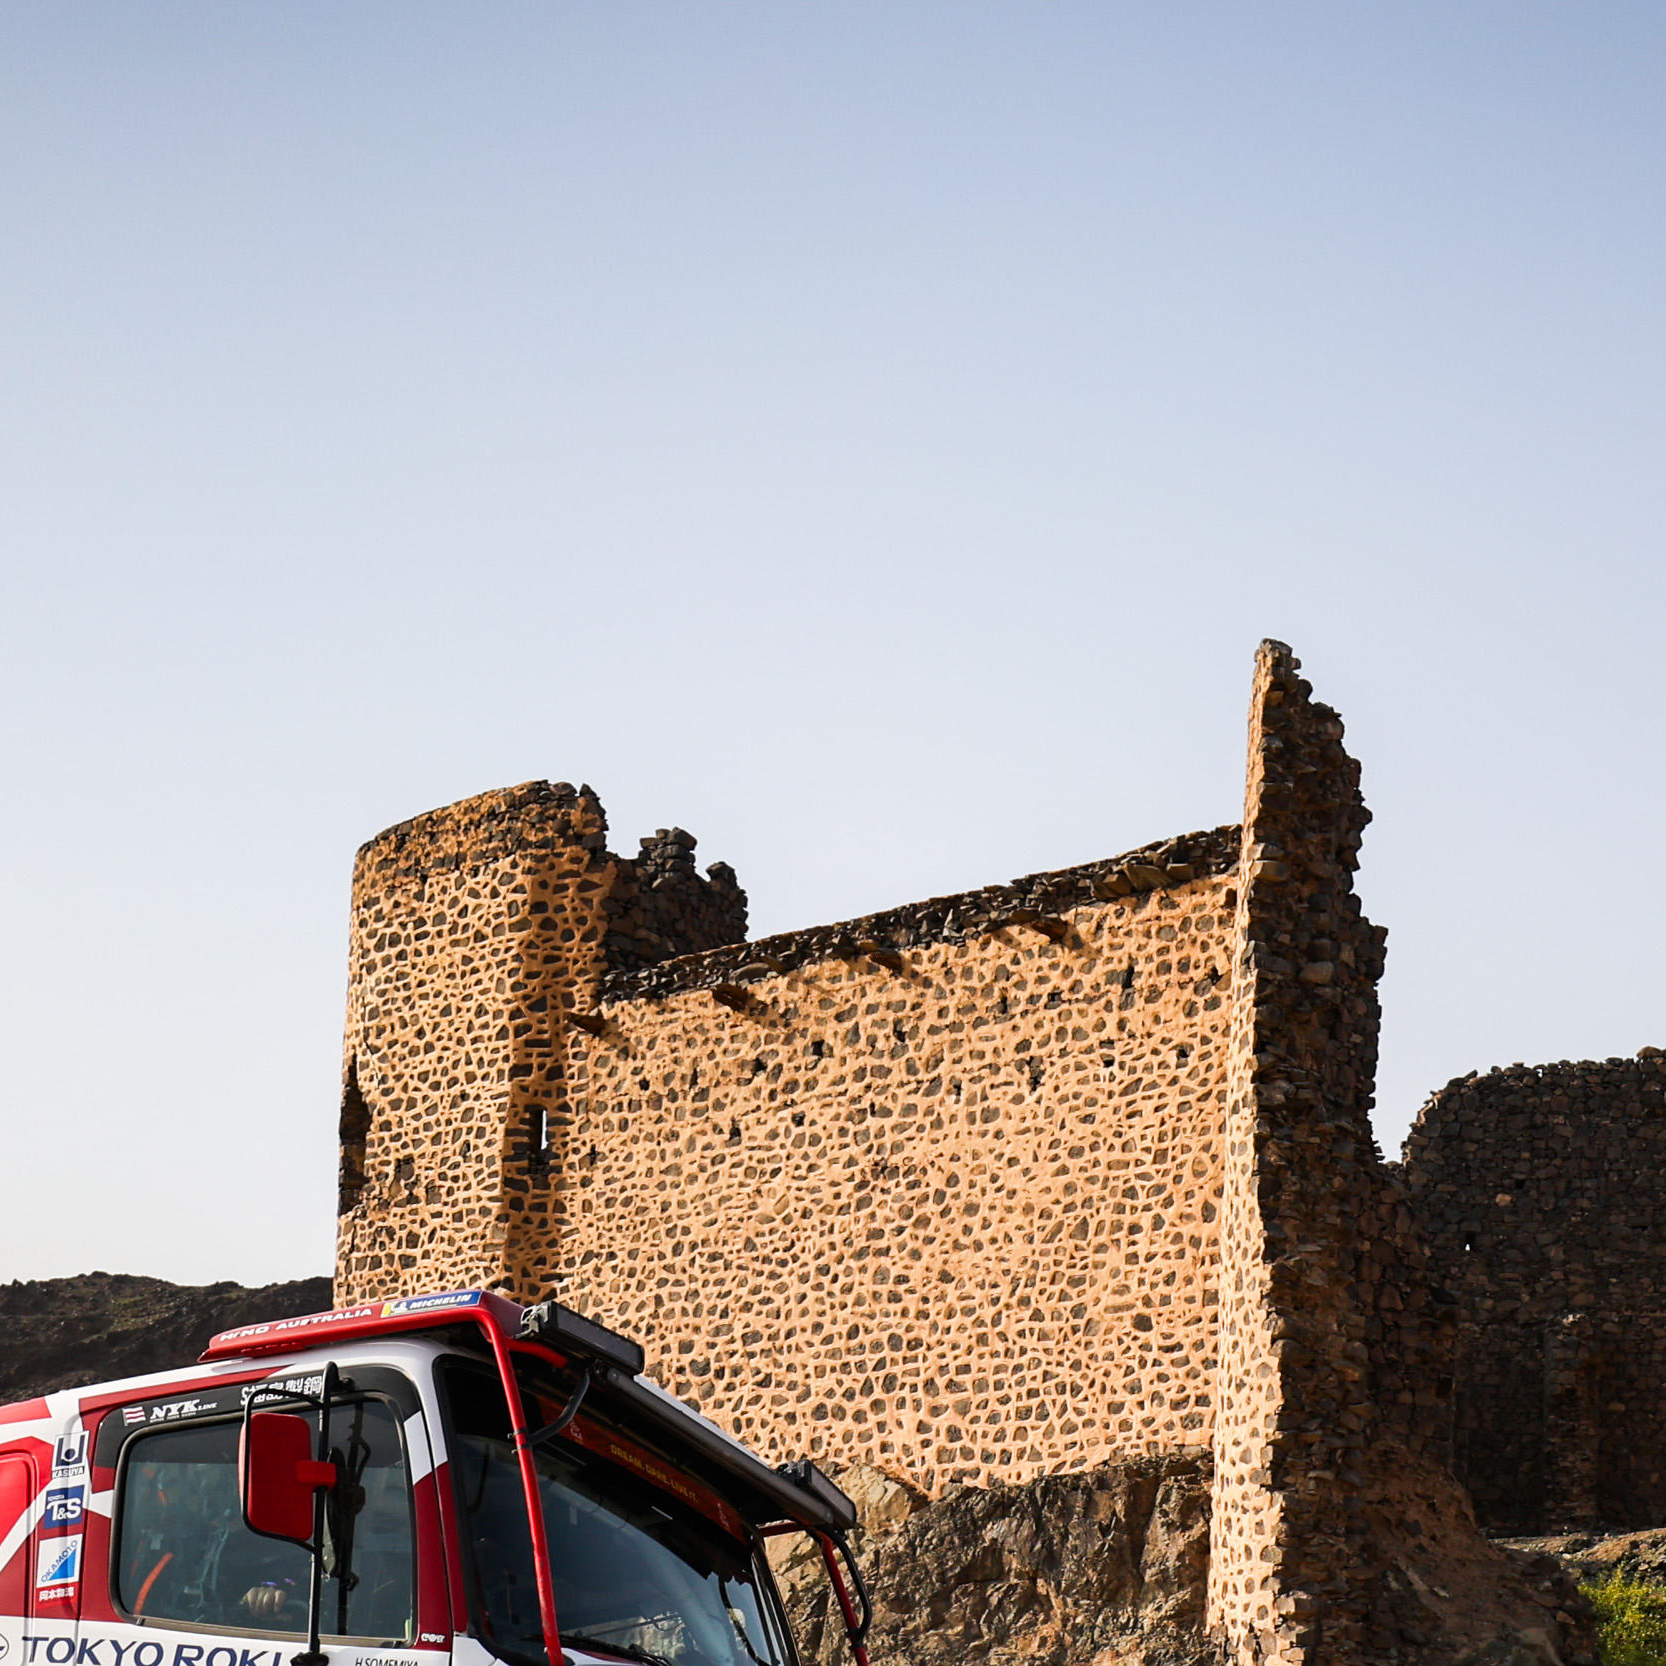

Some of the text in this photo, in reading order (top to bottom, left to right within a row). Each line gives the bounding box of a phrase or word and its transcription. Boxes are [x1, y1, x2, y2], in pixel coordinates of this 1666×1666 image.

[410, 1294, 472, 1309] MICHELIN
[275, 1308, 373, 1330] AUSTRALIA
[150, 1399, 200, 1419] NYK
[52, 1467, 84, 1479] KASUYA
[47, 1498, 83, 1521] T&S
[41, 1540, 78, 1583] OKAMOTO
